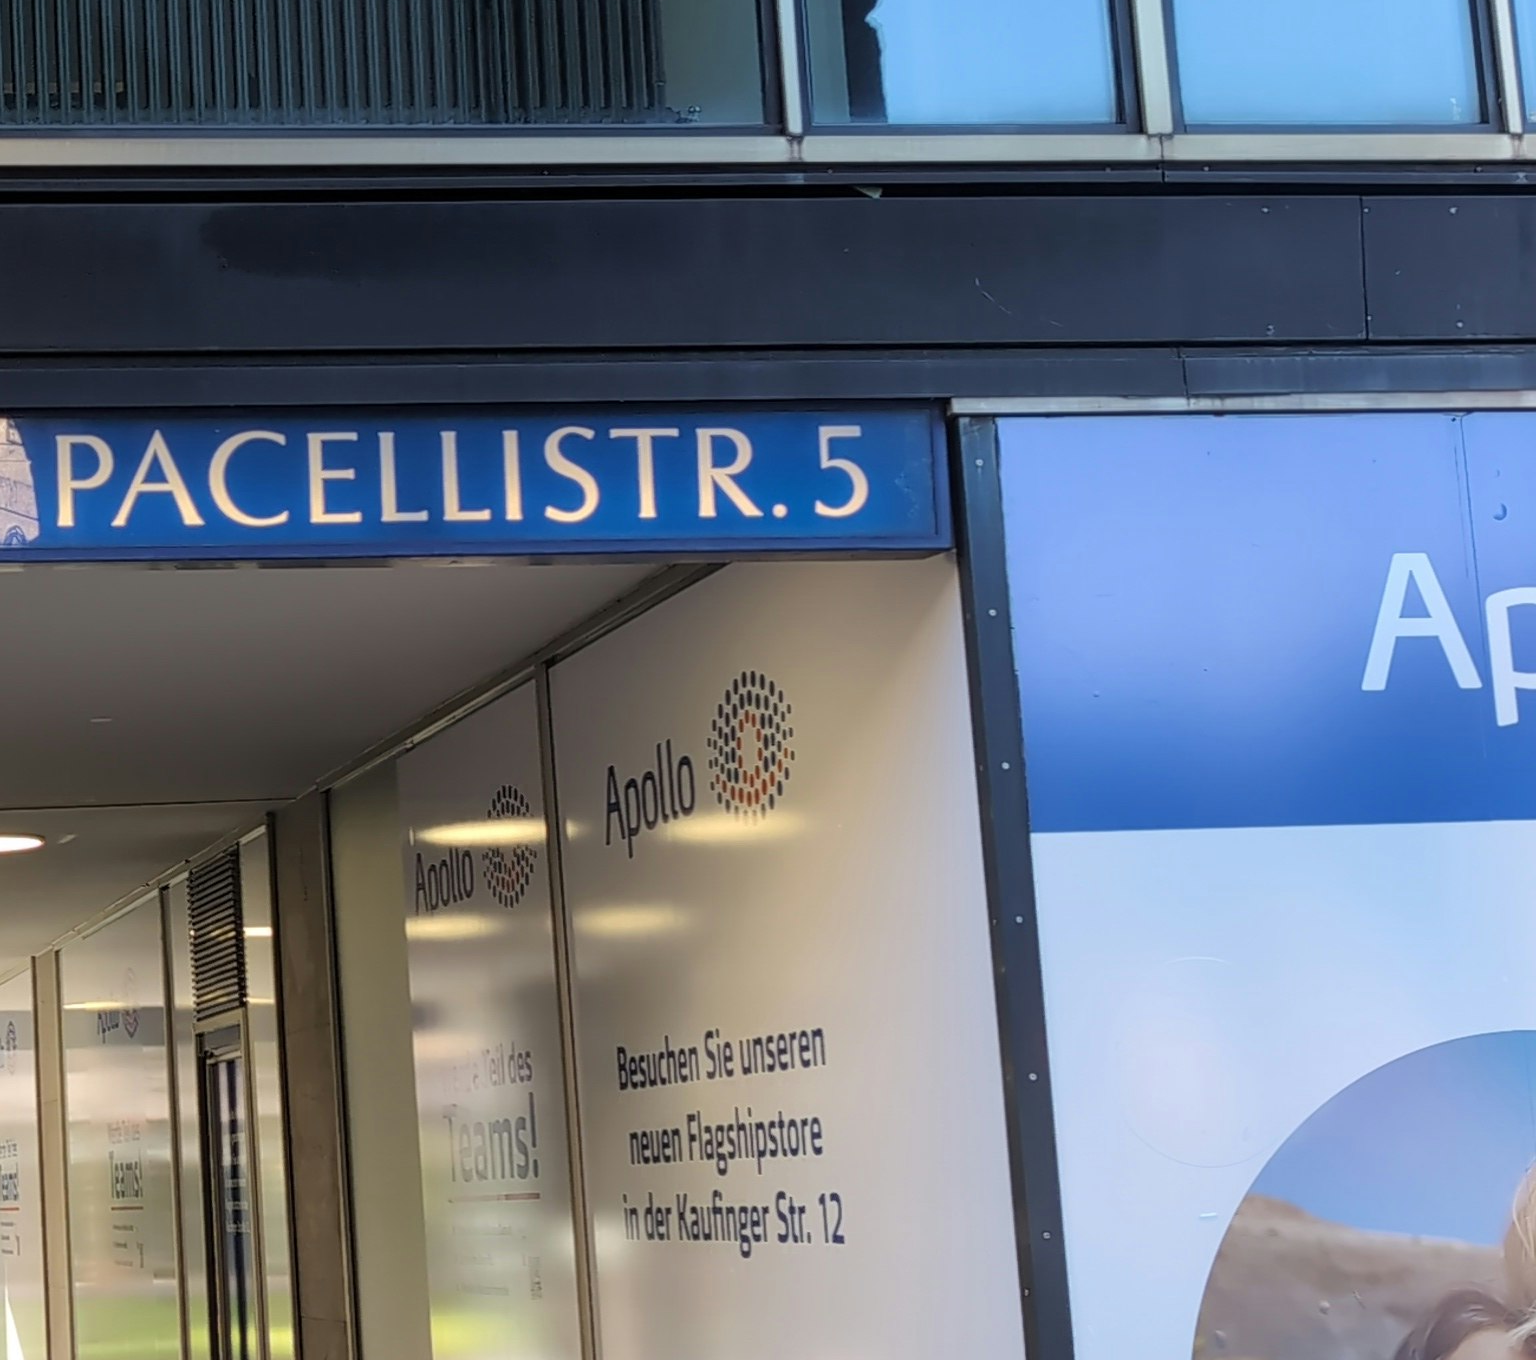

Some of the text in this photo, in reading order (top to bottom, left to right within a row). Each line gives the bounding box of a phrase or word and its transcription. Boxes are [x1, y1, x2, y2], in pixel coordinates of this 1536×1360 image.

[55, 426, 788, 528] PACELLISTR.
[812, 424, 869, 518] 5
[605, 738, 696, 859] Apollo
[414, 848, 475, 916] Apollo
[508, 1042, 533, 1084] des
[616, 1027, 827, 1091] Besuchen Sie unseren
[443, 1091, 540, 1183] Teams!
[629, 1106, 824, 1177] neuen Flagshipstore
[622, 1189, 846, 1259] in der Kaufinger Str. 12
